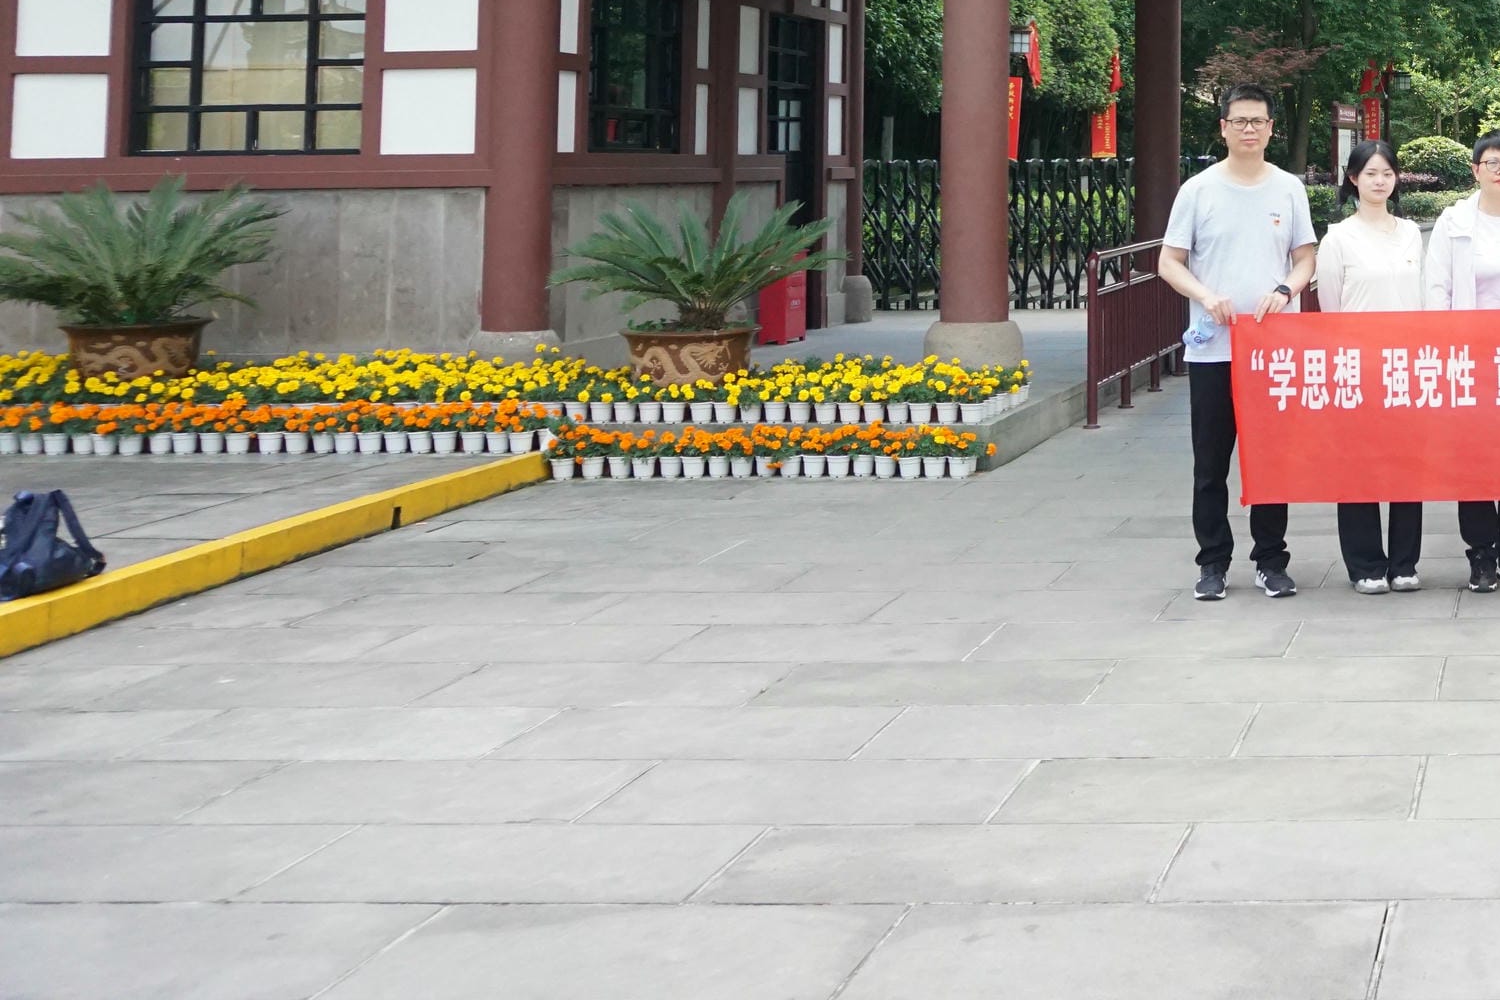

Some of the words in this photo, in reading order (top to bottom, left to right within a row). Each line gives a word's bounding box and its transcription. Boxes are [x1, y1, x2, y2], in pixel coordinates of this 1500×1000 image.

[1250, 346, 1363, 412] “学思想
[1382, 344, 1477, 408] 强党性
